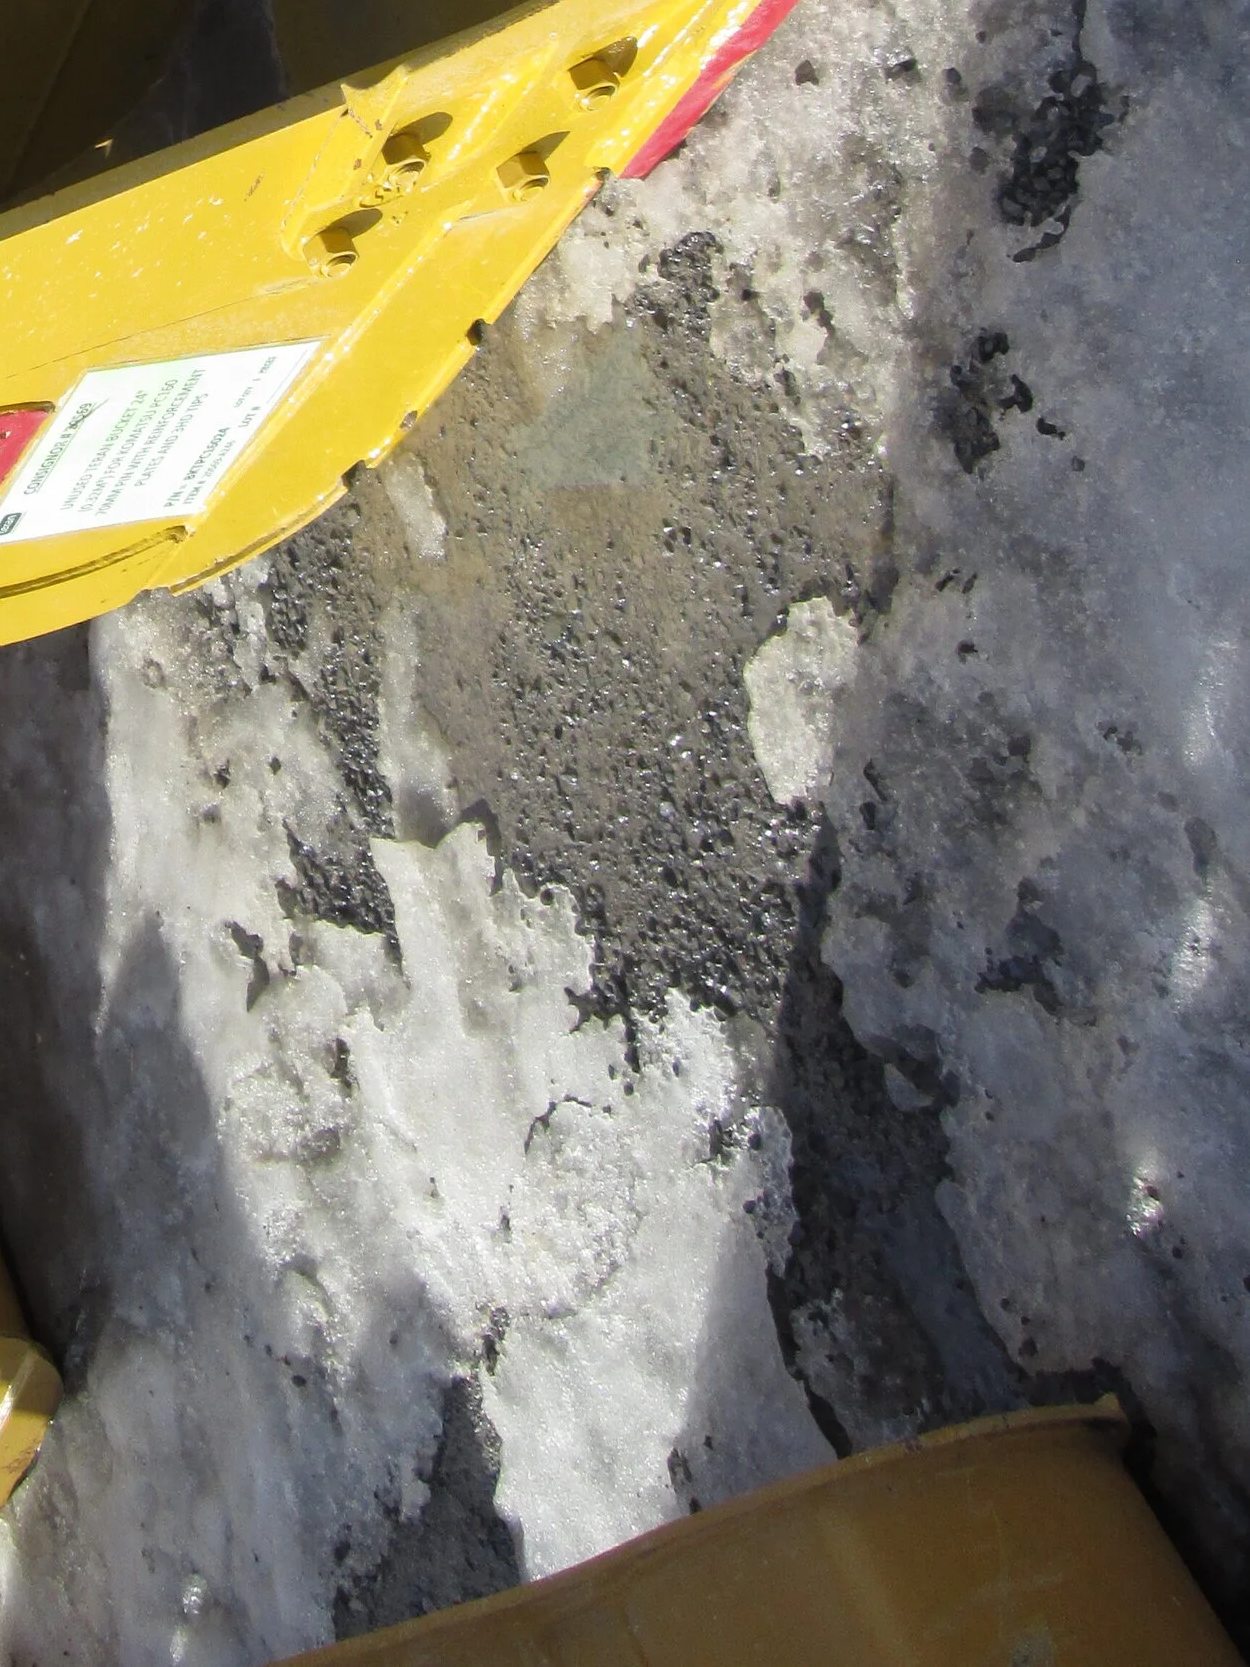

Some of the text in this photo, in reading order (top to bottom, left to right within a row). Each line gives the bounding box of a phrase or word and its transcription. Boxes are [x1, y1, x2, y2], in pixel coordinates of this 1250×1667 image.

[60, 473, 92, 510] UNUSED
[85, 443, 114, 471] TERAN
[105, 407, 137, 441] BUCKET
[96, 369, 205, 514] 70MM PIN WITH REINFORCEMENT
[103, 456, 123, 474] FOR
[119, 409, 156, 454] KOMATSU
[149, 379, 178, 407] PC160
[133, 455, 164, 486] PLATES
[157, 434, 178, 454] AND
[186, 393, 208, 411] TIPS
[237, 413, 255, 427] LOT
[23, 440, 68, 495] CONSIGNOR
[163, 490, 183, 507] P/N
